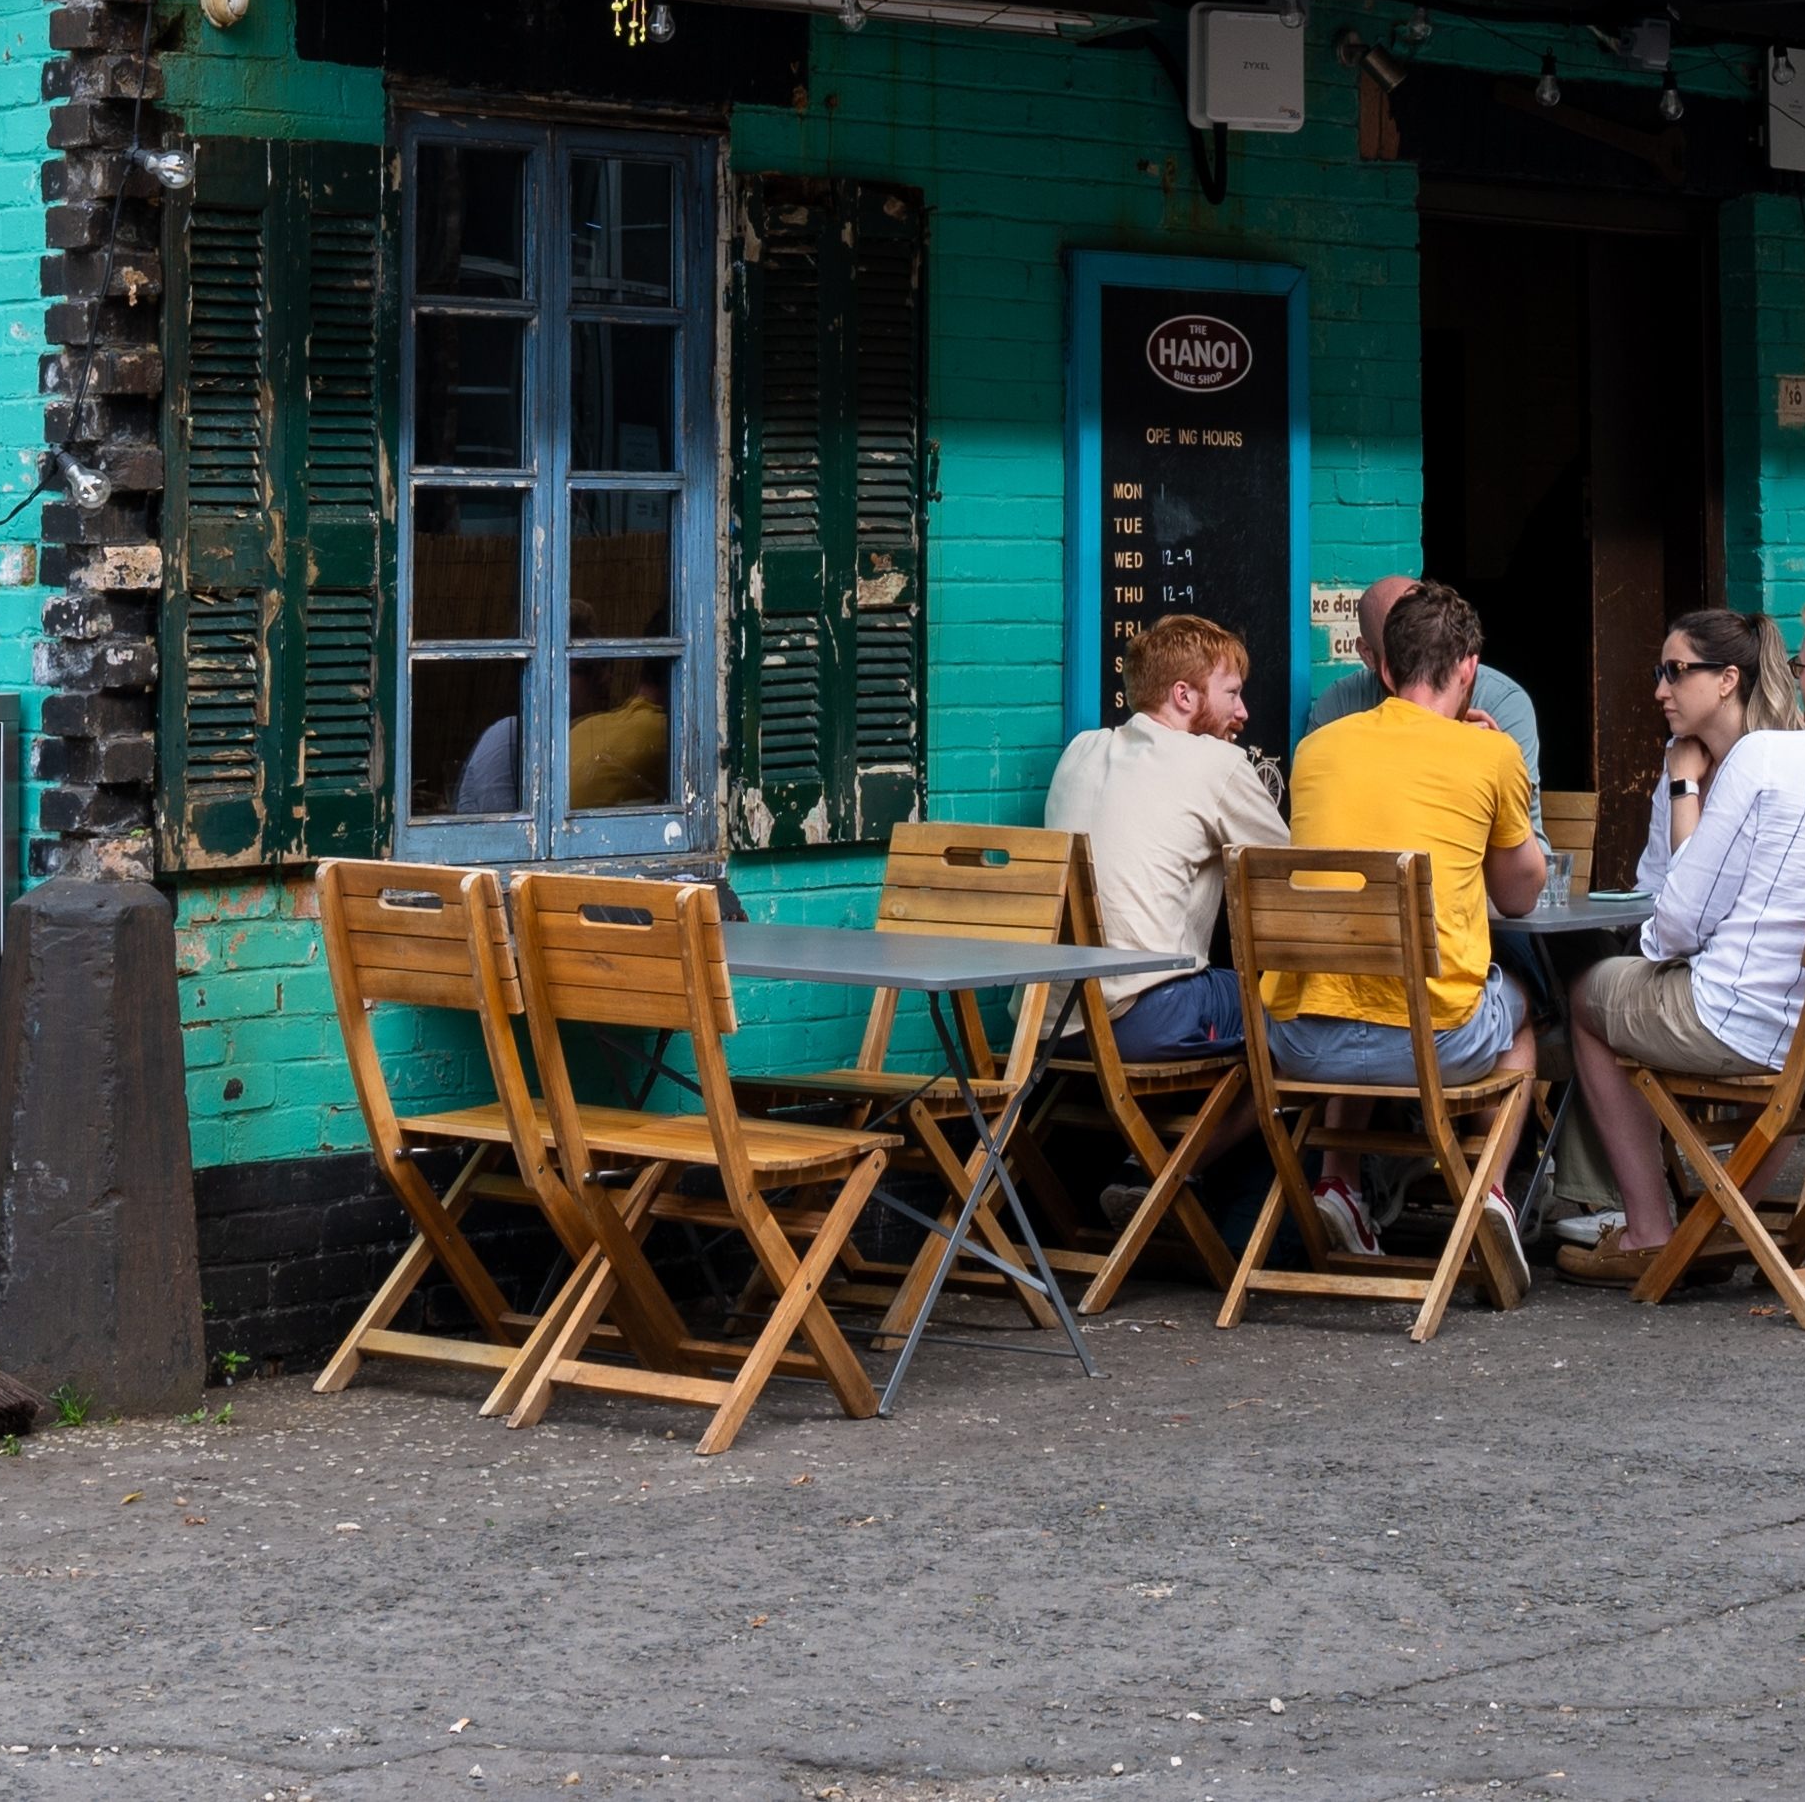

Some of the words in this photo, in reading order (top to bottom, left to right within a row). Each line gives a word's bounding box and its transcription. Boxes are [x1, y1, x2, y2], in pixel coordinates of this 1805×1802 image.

[1242, 61, 1270, 71] ZYXEL
[1189, 324, 1207, 336] THE
[1159, 337, 1237, 370] HANOI
[1173, 369, 1196, 385] BIKE
[1198, 371, 1223, 385] SHOP
[1202, 429, 1243, 447] HOURS
[1113, 483, 1143, 500] MON
[1114, 517, 1143, 534] TUE
[1114, 551, 1143, 569] WED
[1115, 586, 1144, 603] THU
[1313, 598, 1329, 614] xe
